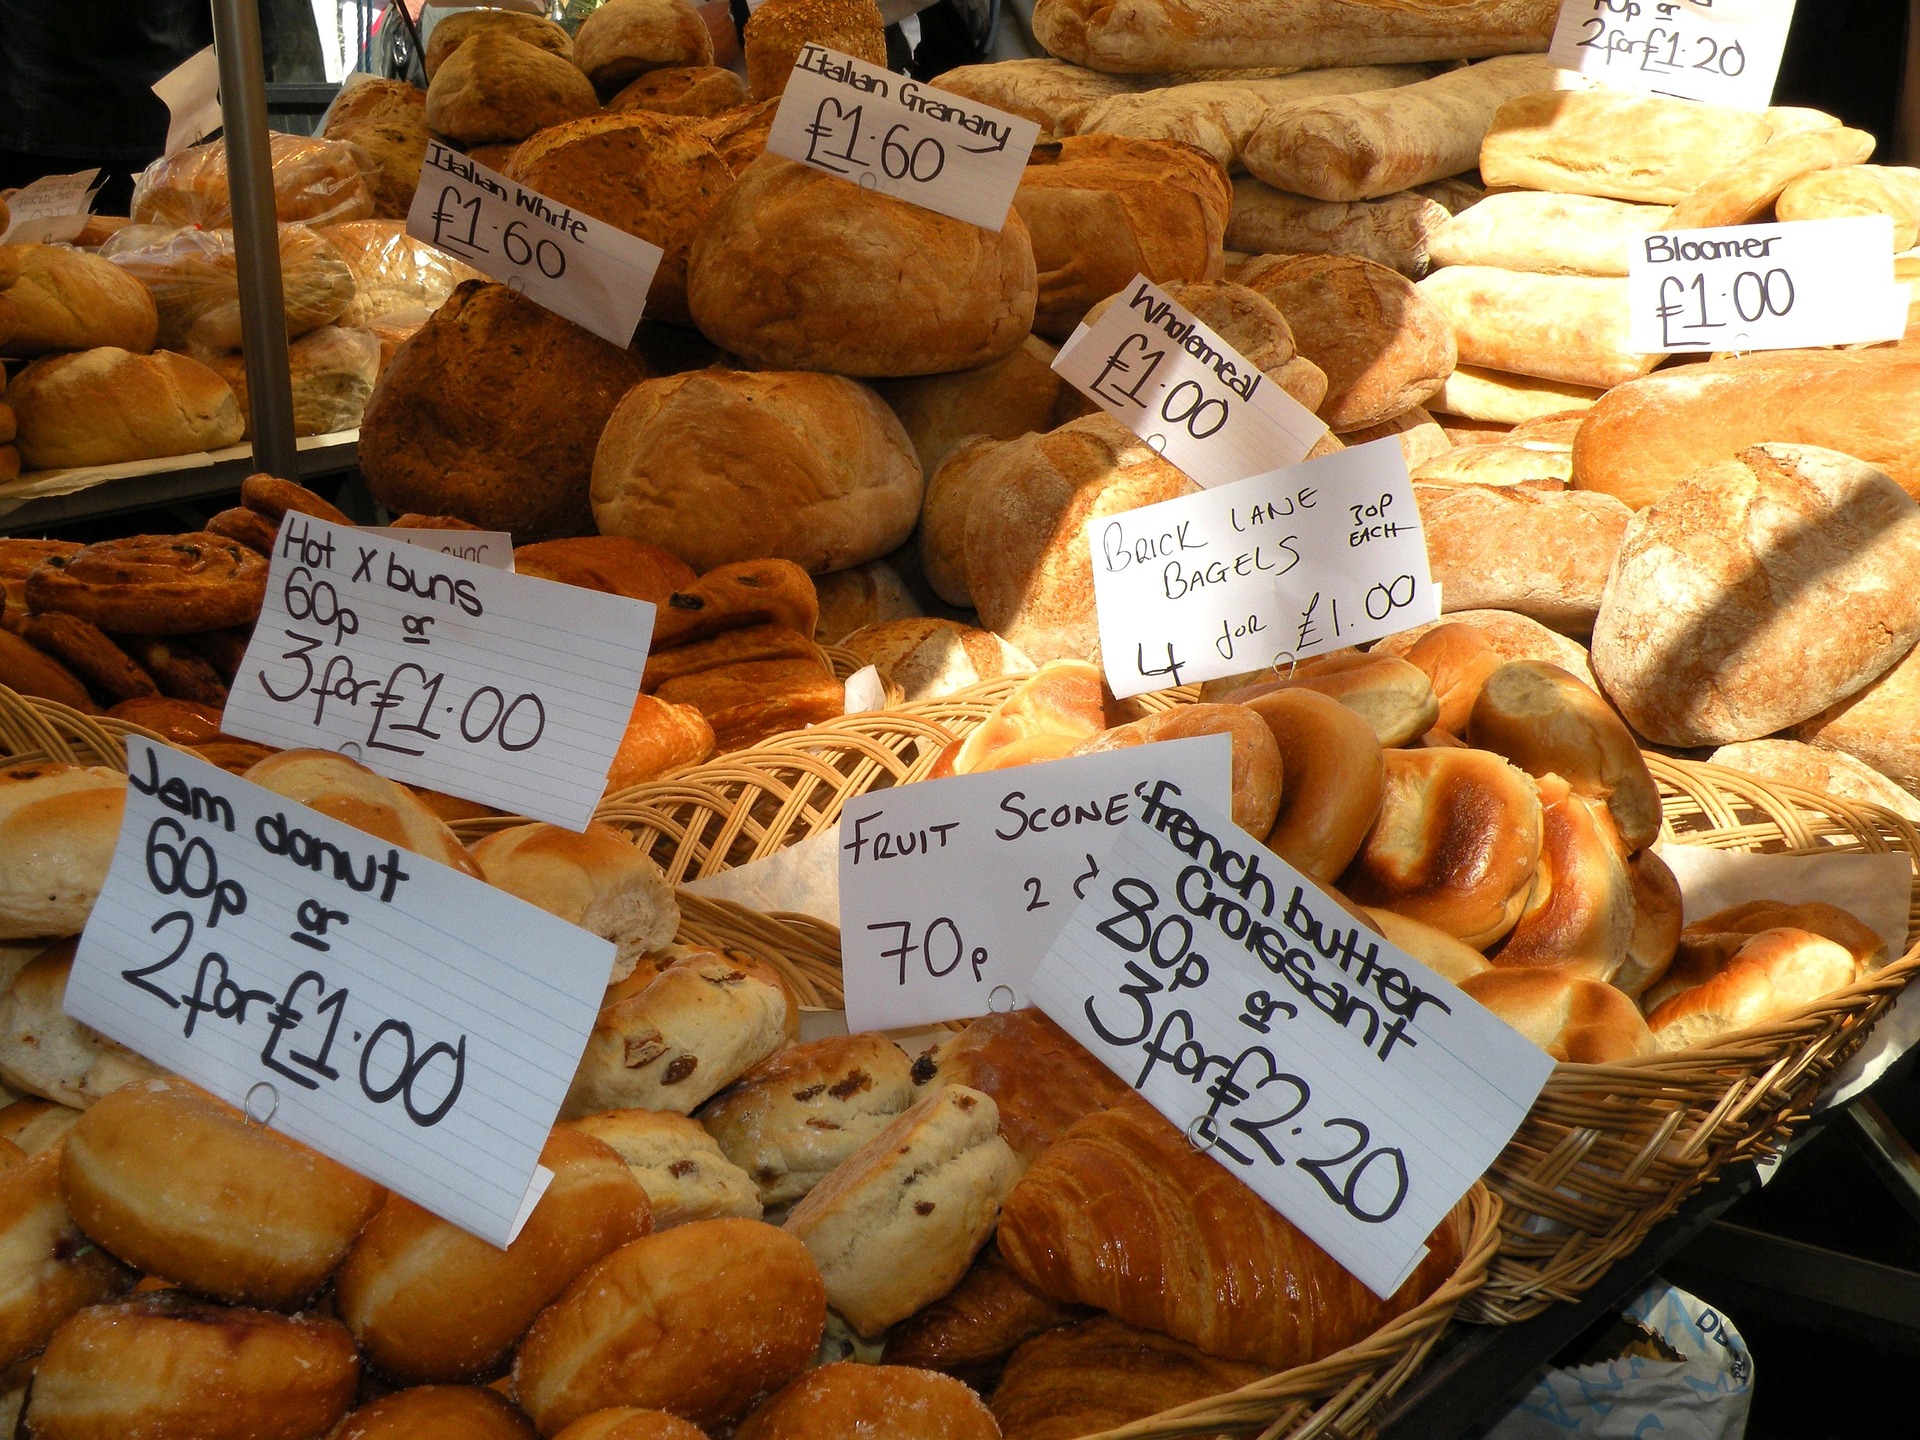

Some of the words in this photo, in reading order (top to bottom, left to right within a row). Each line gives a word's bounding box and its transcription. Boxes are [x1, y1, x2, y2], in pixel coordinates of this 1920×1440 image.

[1592, 0, 1641, 22] 0p
[794, 45, 889, 98] Italian
[899, 82, 1013, 154] Granary
[804, 96, 946, 183] £1.60
[424, 143, 508, 202] Italian
[515, 188, 589, 245] White
[431, 185, 567, 280] £1.60
[1643, 234, 1783, 264] Bloomer
[1128, 283, 1263, 403] Wholemeal
[1655, 267, 1796, 348] £1.00
[1089, 333, 1230, 440] £1.00
[281, 516, 337, 570] Hot
[386, 551, 484, 618] buns
[1102, 520, 1209, 573] BRICK
[1229, 486, 1319, 532] LANE
[1163, 535, 1301, 601] BAGELS
[1348, 521, 1420, 549] EACH
[284, 565, 360, 647] 60p
[401, 613, 436, 645] or
[1137, 641, 1187, 688] 4
[1295, 574, 1416, 653] £1.00
[129, 746, 236, 833] Jam
[253, 811, 411, 903] donut
[843, 810, 961, 866] FRUIT
[144, 816, 248, 929] 60p
[290, 899, 351, 953] or
[1023, 876, 1051, 913] 2
[1140, 779, 1276, 918] French
[1282, 886, 1453, 1023] butter
[866, 916, 990, 986] 70p
[1095, 876, 1210, 994] 80p
[1238, 988, 1299, 1036] or
[1174, 864, 1418, 1064] Croissant
